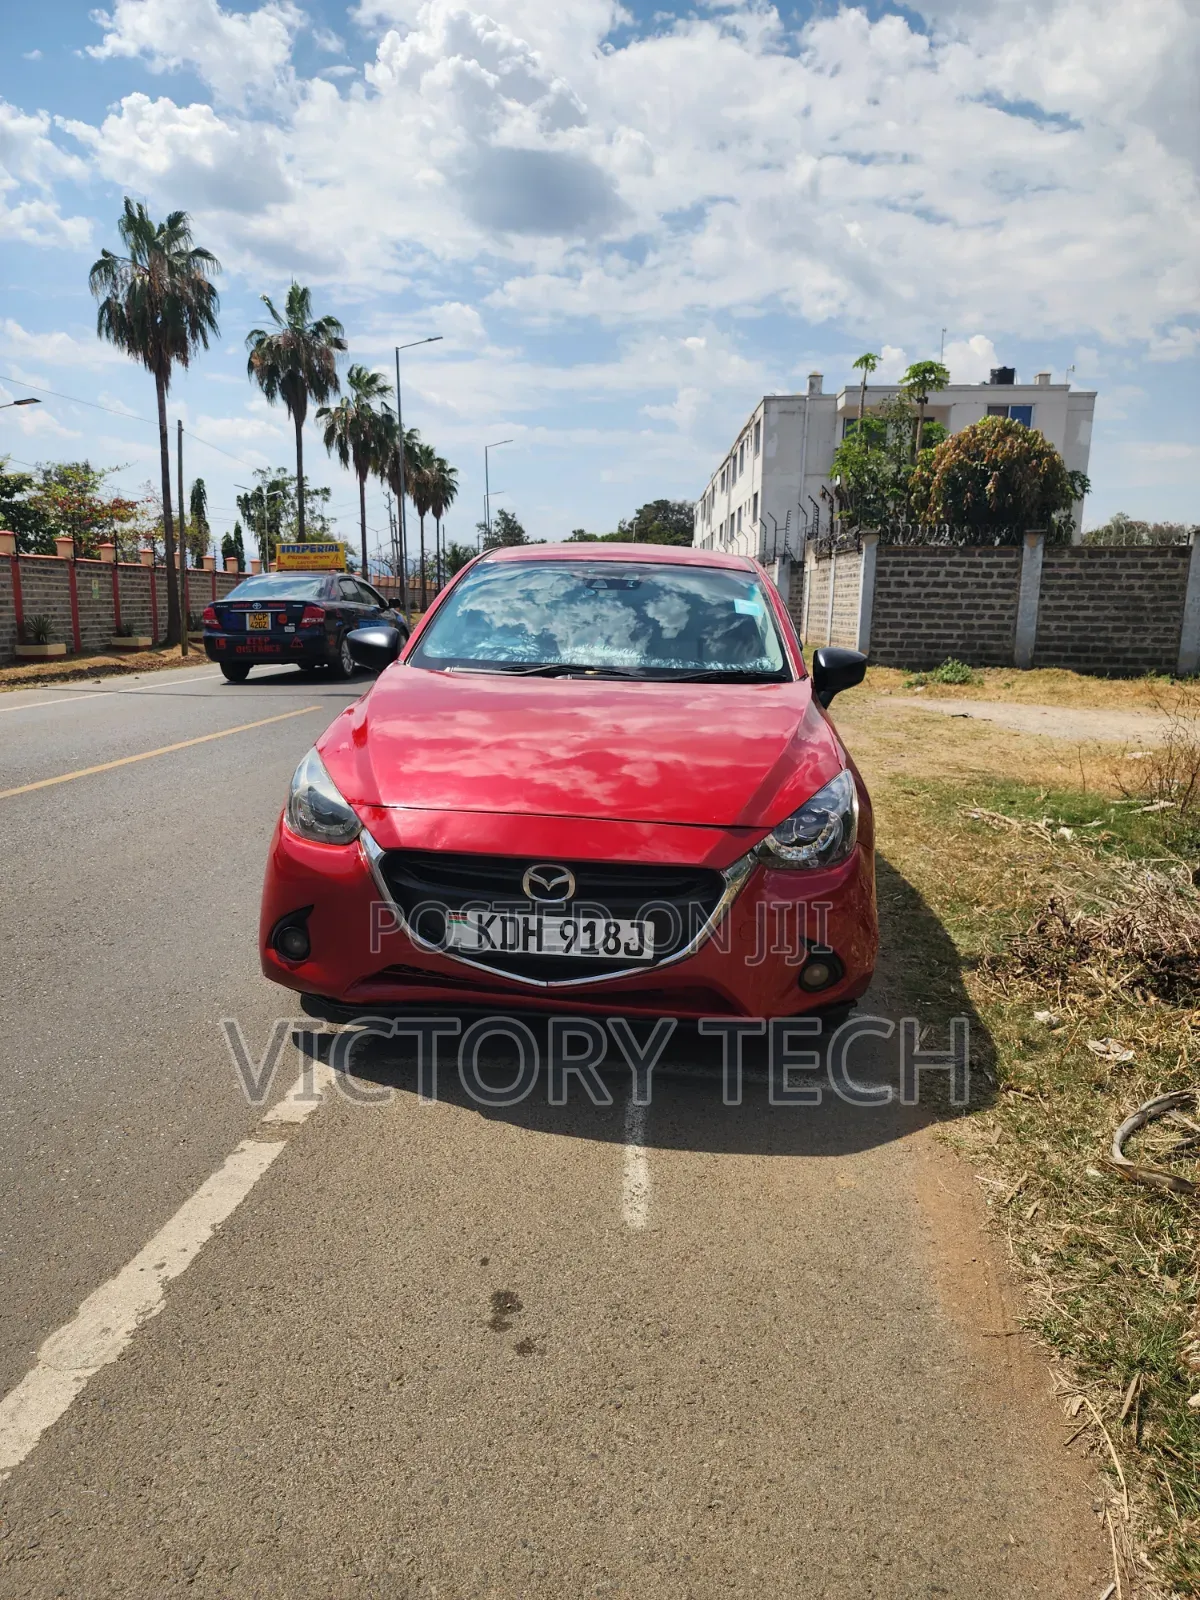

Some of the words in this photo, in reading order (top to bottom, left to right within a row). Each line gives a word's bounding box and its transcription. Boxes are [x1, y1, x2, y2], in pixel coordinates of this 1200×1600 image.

[281, 544, 340, 553] IMPERIAL
[253, 613, 268, 621] KCP
[235, 644, 281, 653] DISTANCE
[477, 913, 543, 952] KDH
[559, 919, 646, 957] 918J
